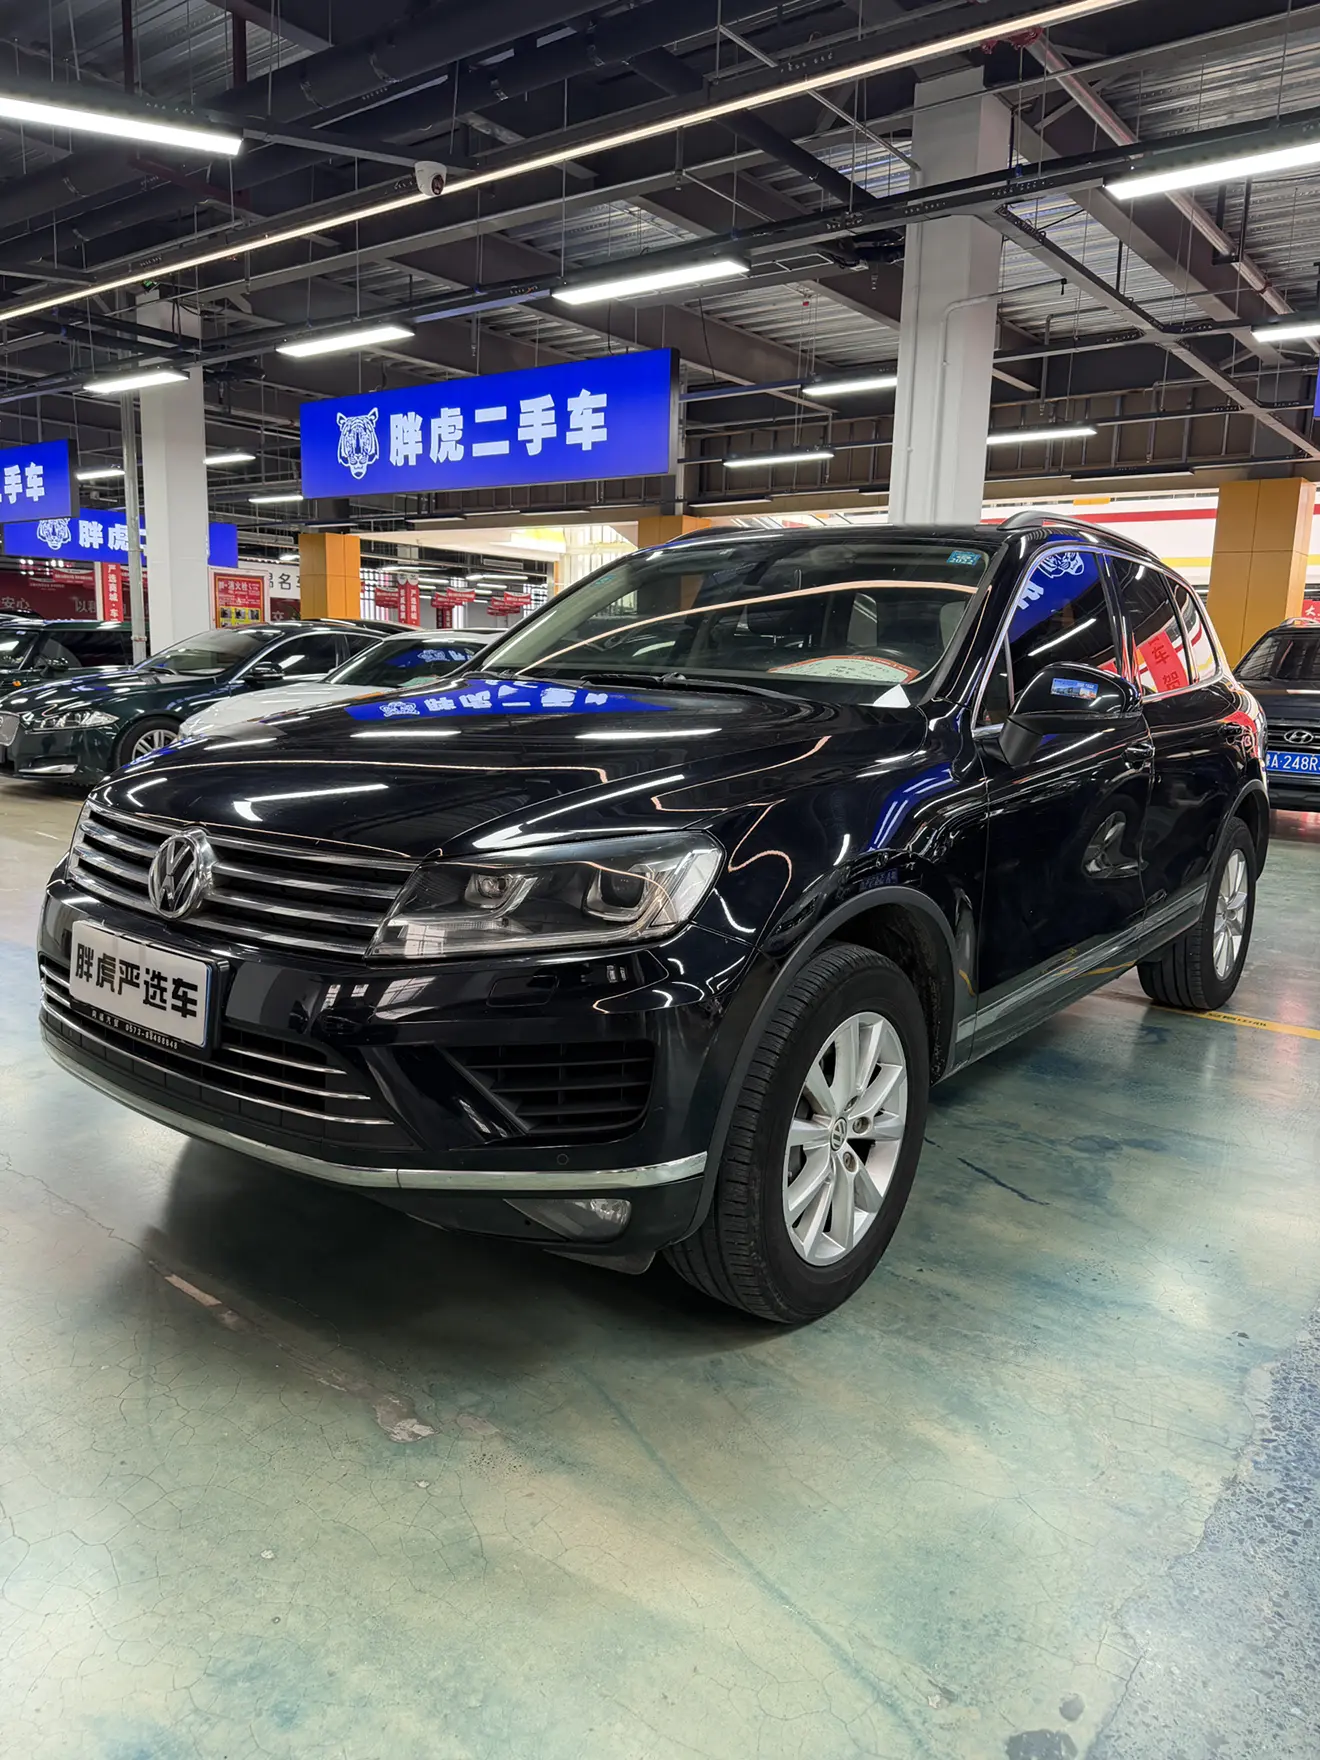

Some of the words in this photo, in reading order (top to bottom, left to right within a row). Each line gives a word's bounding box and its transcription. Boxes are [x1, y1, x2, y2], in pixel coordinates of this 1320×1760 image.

[389, 388, 609, 467] 胖虎二手车
[0, 462, 45, 505] 手车
[75, 943, 198, 1019] 胖虎严选车
